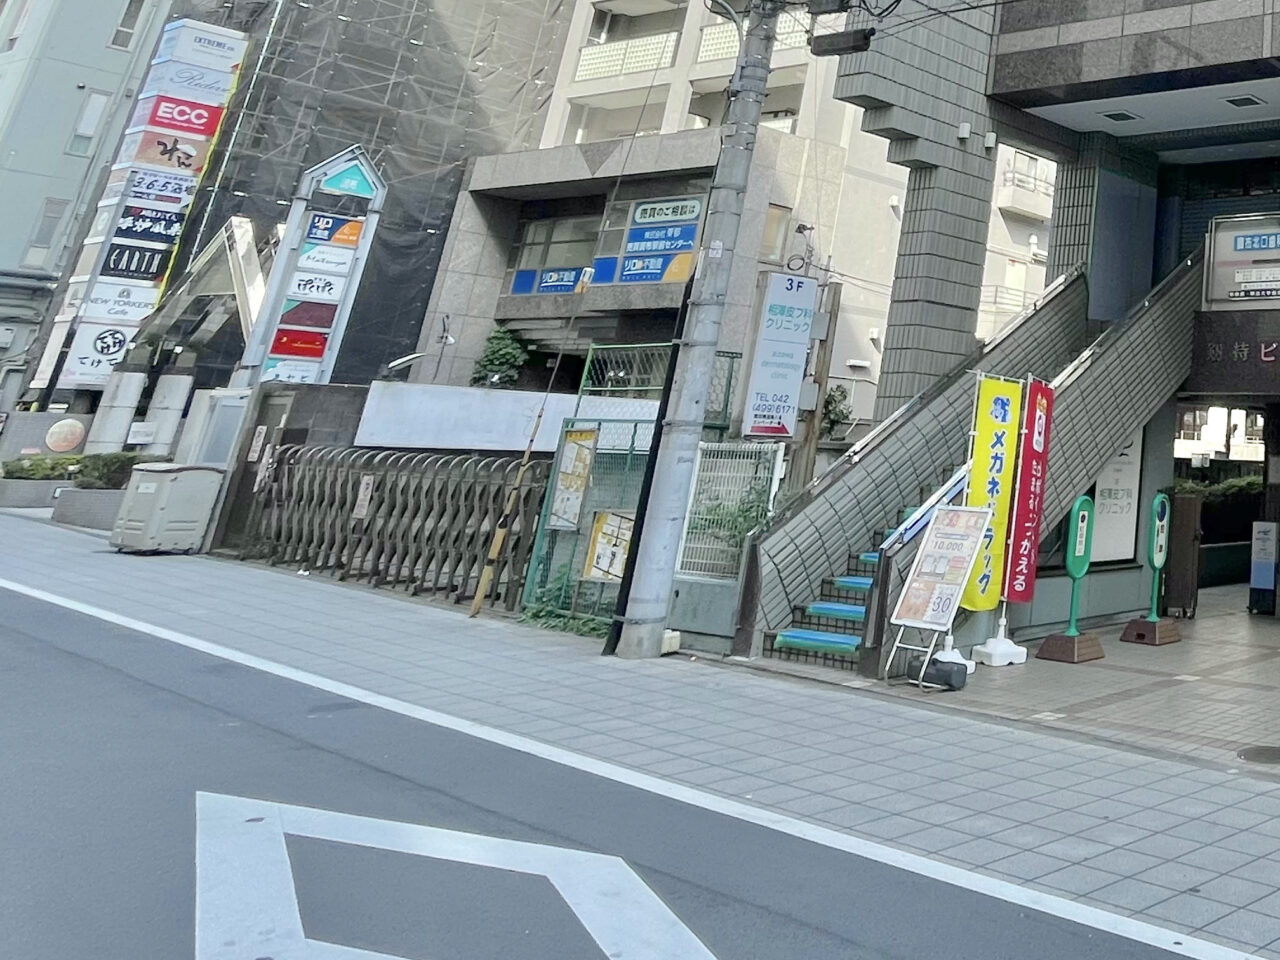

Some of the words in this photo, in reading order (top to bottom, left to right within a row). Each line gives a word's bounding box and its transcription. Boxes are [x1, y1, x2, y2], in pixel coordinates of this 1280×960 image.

[156, 101, 209, 125] ECC
[110, 249, 164, 273] EARTH
[766, 319, 810, 333] クリニック
[755, 392, 769, 403] TEL
[772, 393, 789, 403] 042
